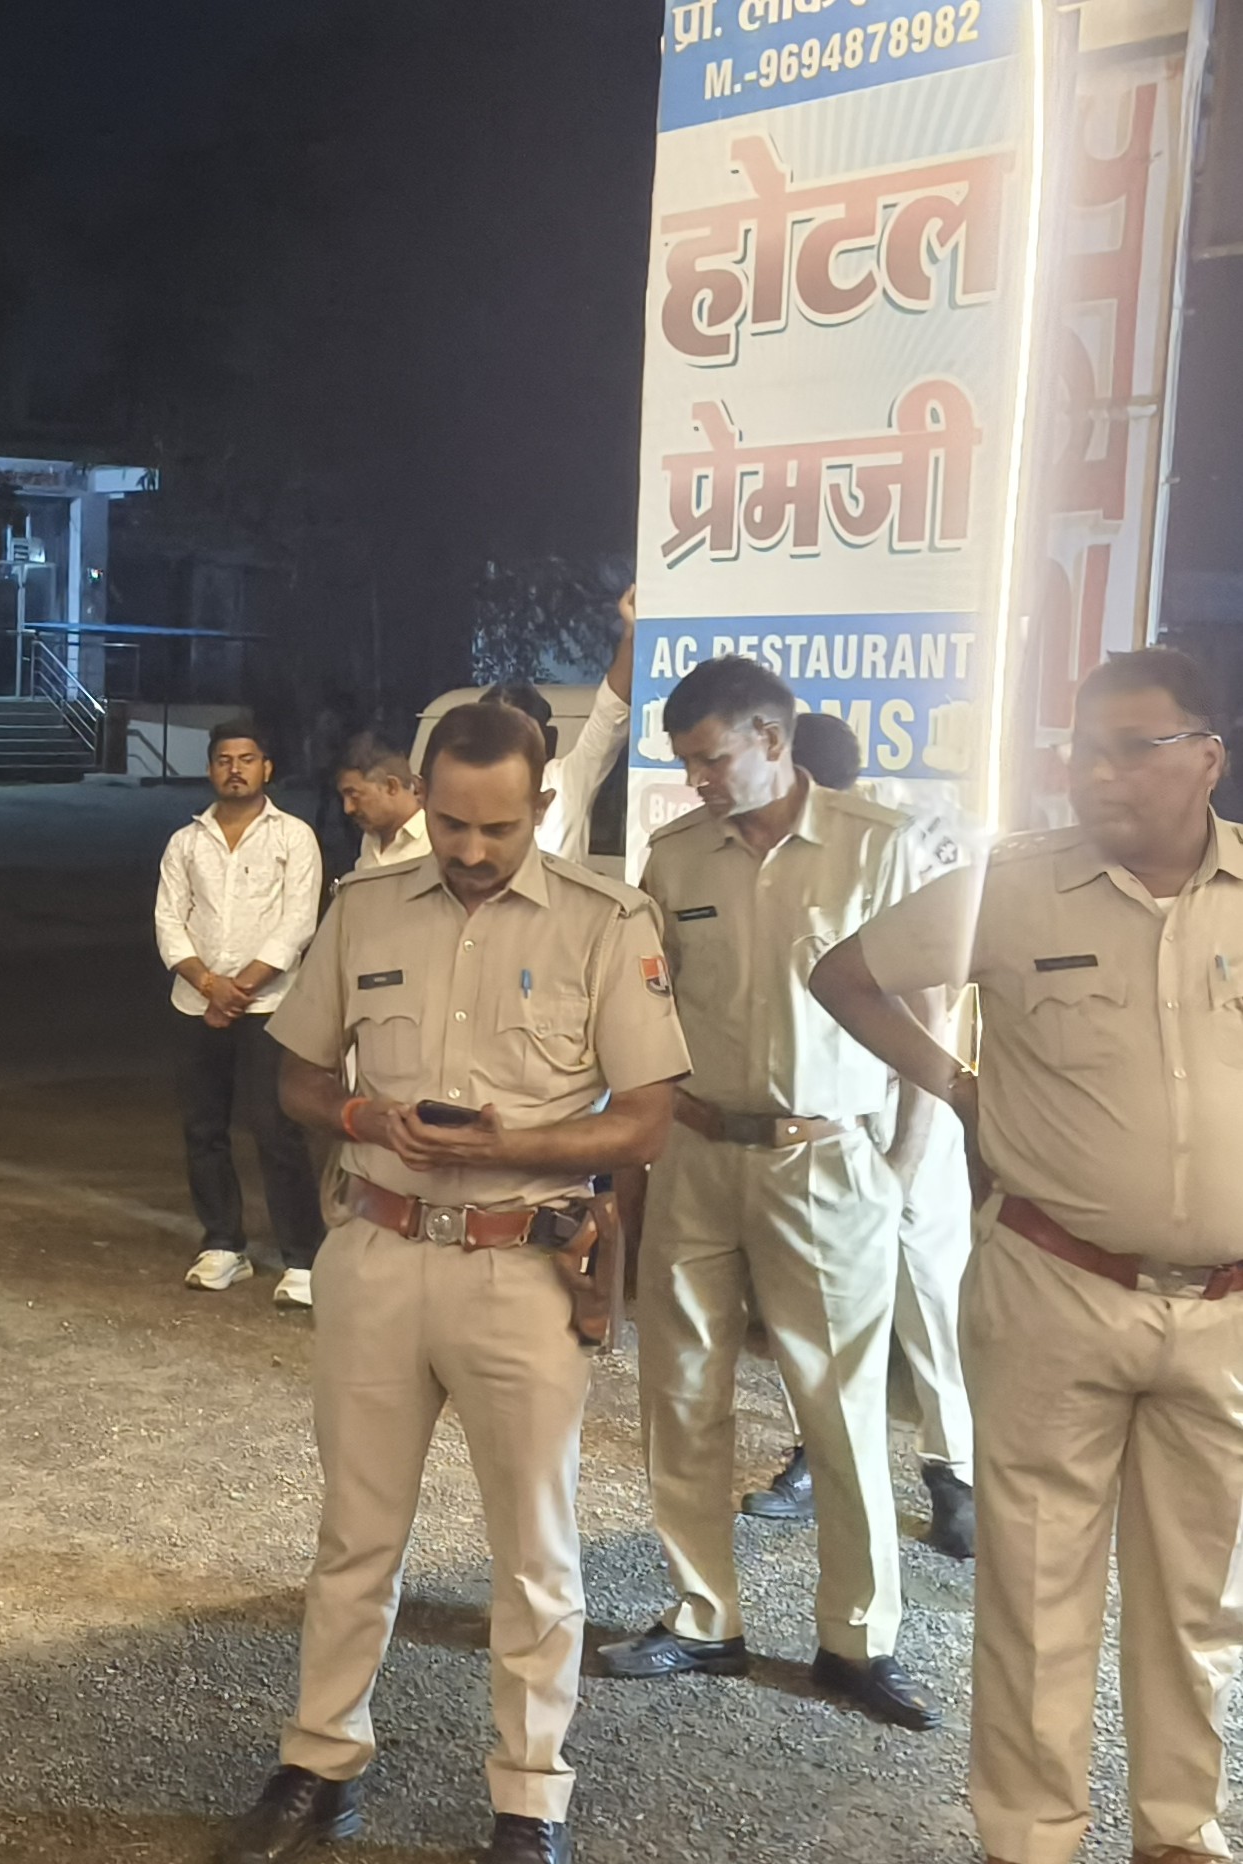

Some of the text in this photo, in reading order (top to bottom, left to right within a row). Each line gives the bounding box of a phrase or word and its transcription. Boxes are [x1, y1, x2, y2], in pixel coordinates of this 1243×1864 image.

[704, 0, 981, 100] M.-9694878982
[658, 134, 1015, 362] होटल
[660, 378, 984, 562] प्रेमजी
[650, 635, 697, 679] AC
